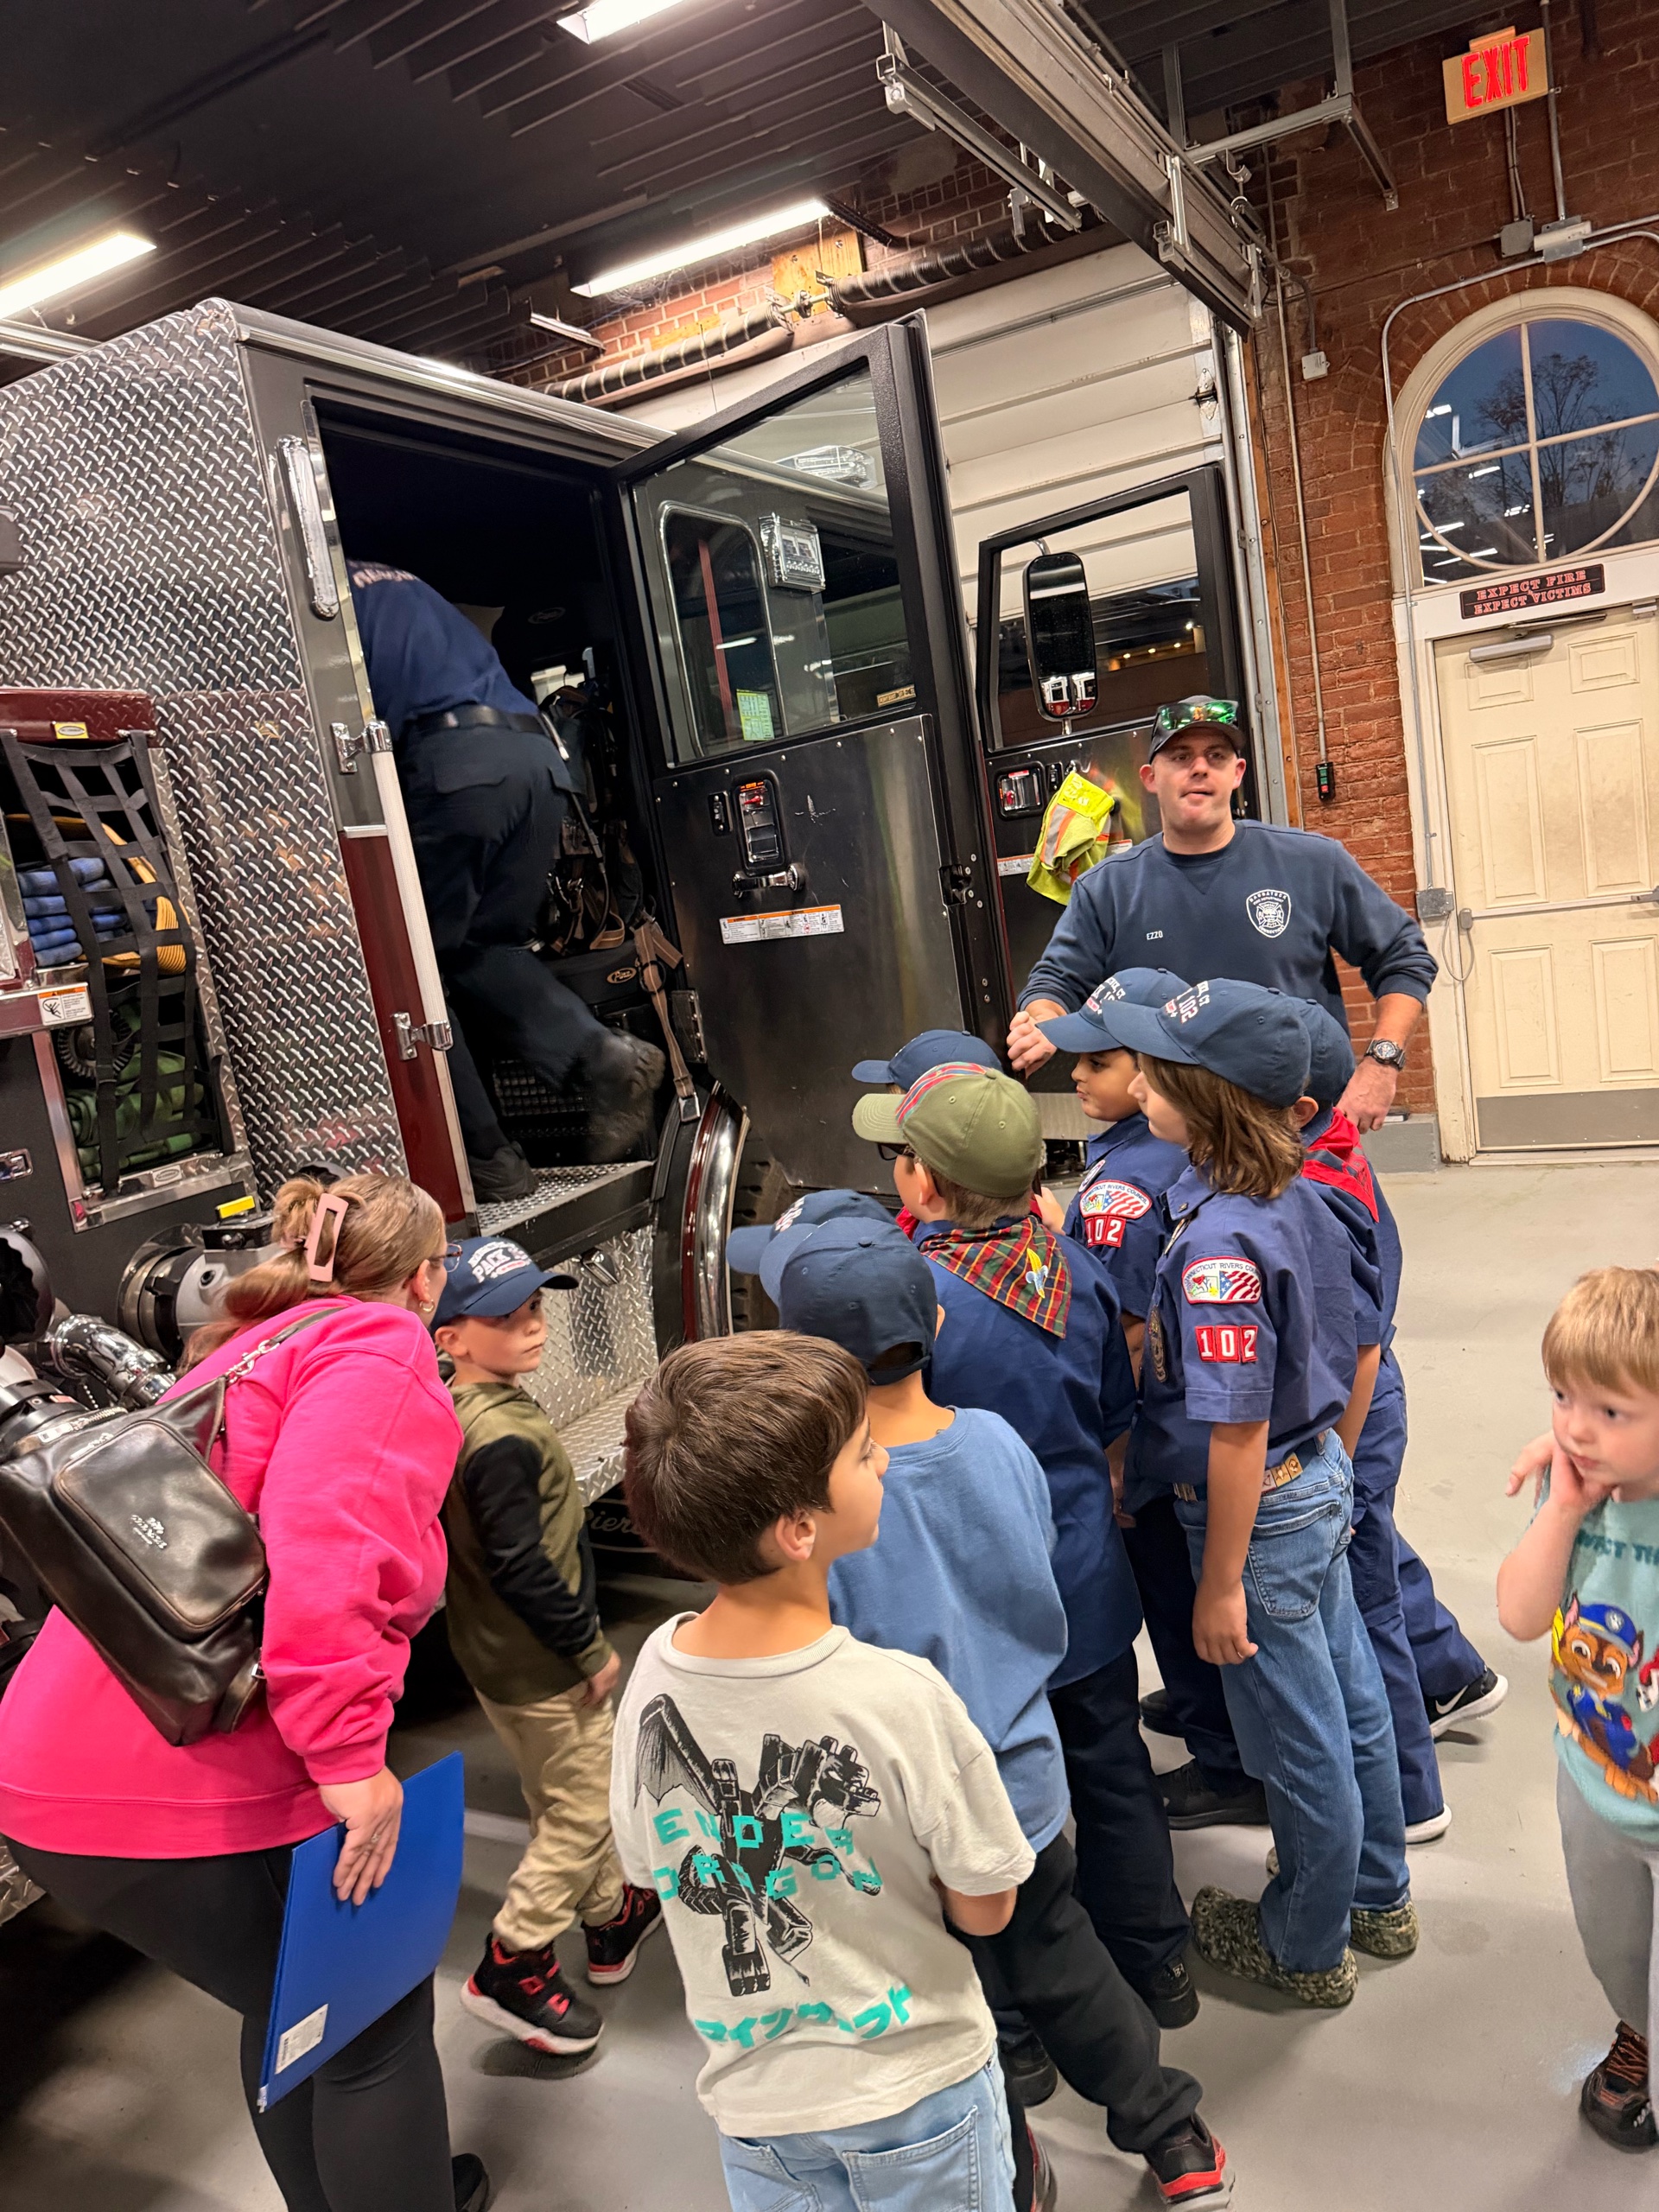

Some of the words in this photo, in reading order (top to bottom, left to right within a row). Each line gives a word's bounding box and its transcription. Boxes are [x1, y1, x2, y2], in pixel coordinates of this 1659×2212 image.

[1462, 35, 1530, 109] EXIT
[1474, 595, 1528, 615] EXPECT
[1532, 582, 1592, 604] VICTIMS
[1477, 579, 1541, 601] EXPECT
[1546, 570, 1586, 588] FIRE
[1146, 930, 1164, 940] EZZO
[1179, 995, 1198, 1024] 102
[1087, 1219, 1122, 1243] 102
[472, 1249, 512, 1283] PACK
[1200, 1330, 1256, 1358] 102
[652, 1808, 855, 1856] ENDER
